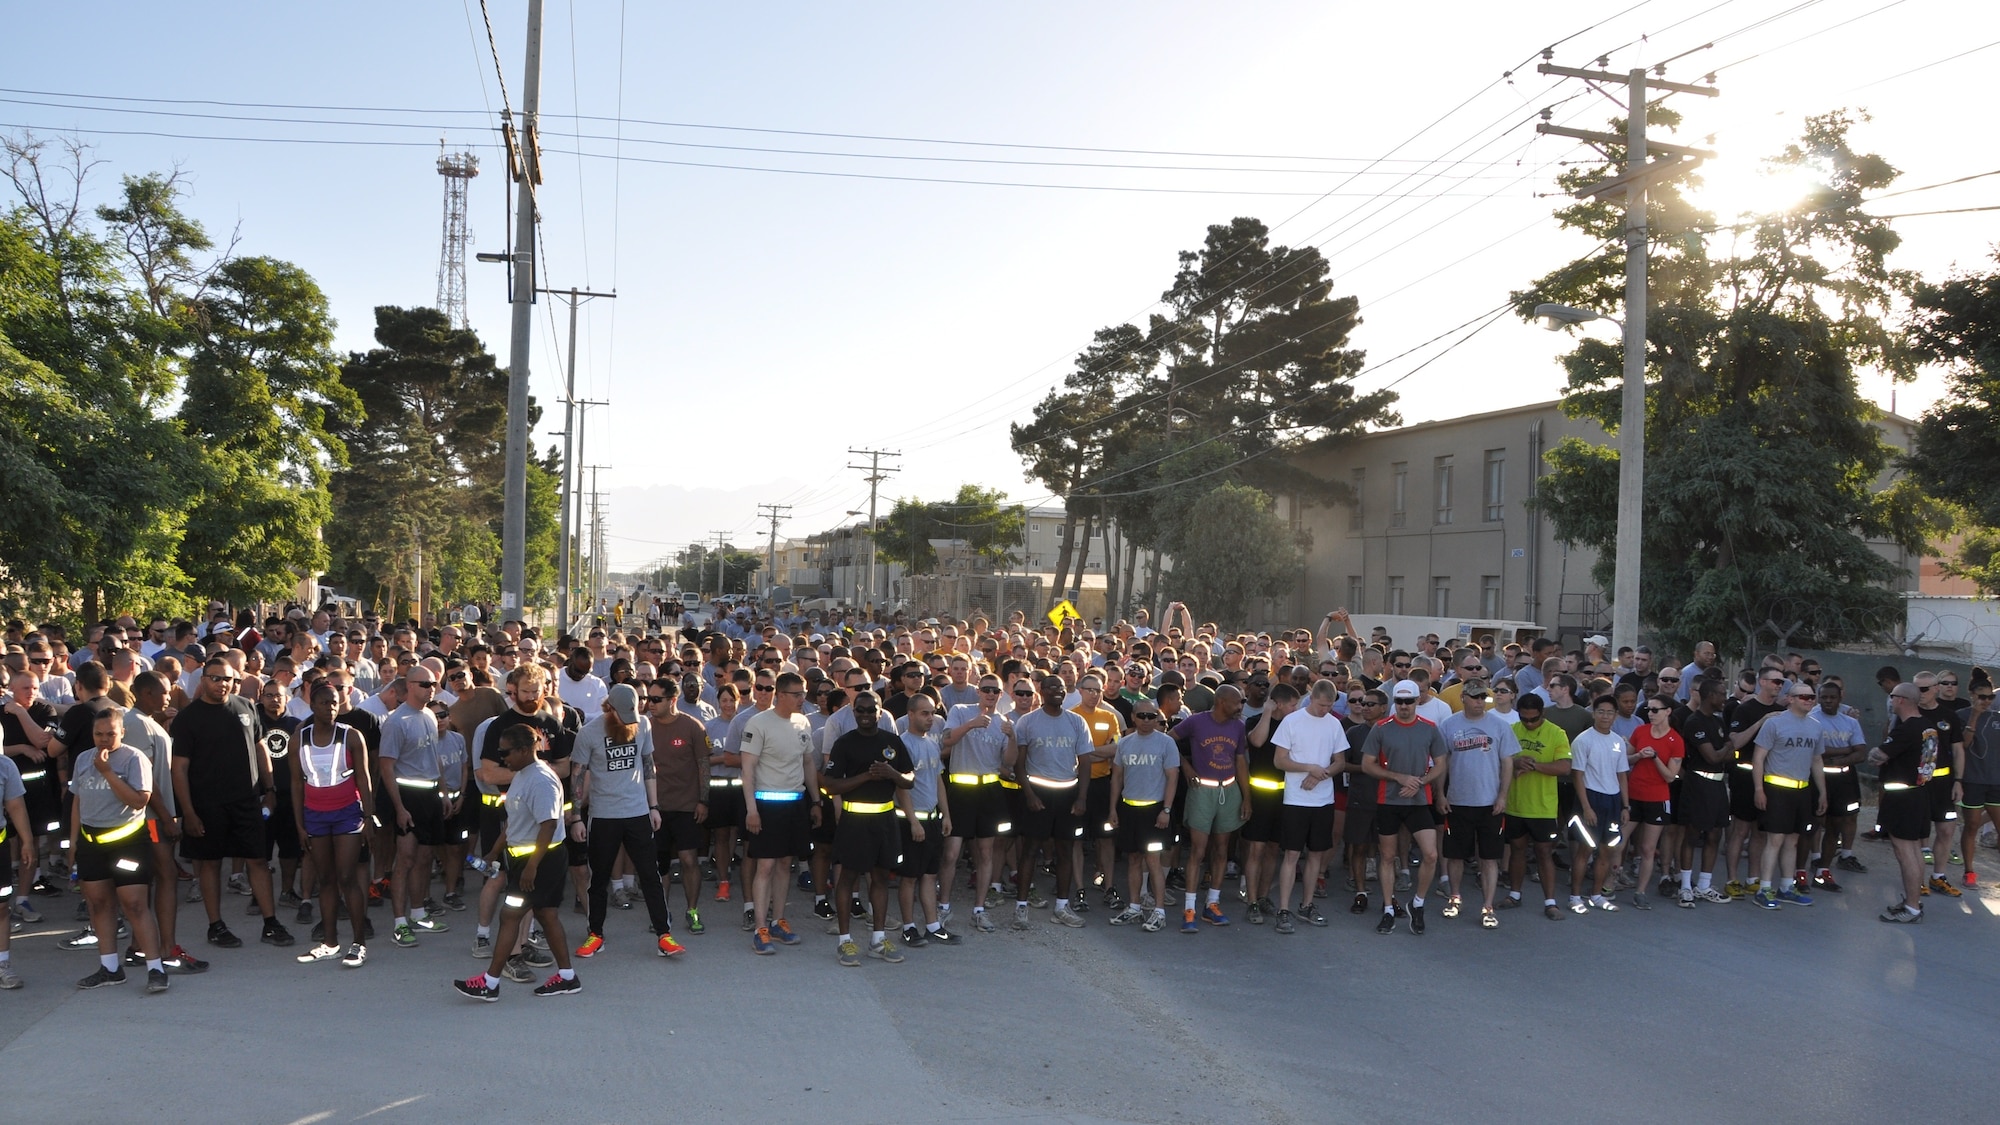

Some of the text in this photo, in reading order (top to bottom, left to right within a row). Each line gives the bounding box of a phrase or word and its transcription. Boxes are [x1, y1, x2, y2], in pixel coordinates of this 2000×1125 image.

[1036, 736, 1073, 748] ARMY
[607, 746, 635, 759] YOUR
[608, 759, 633, 771] SELF
[1122, 754, 1157, 766] ARMY
